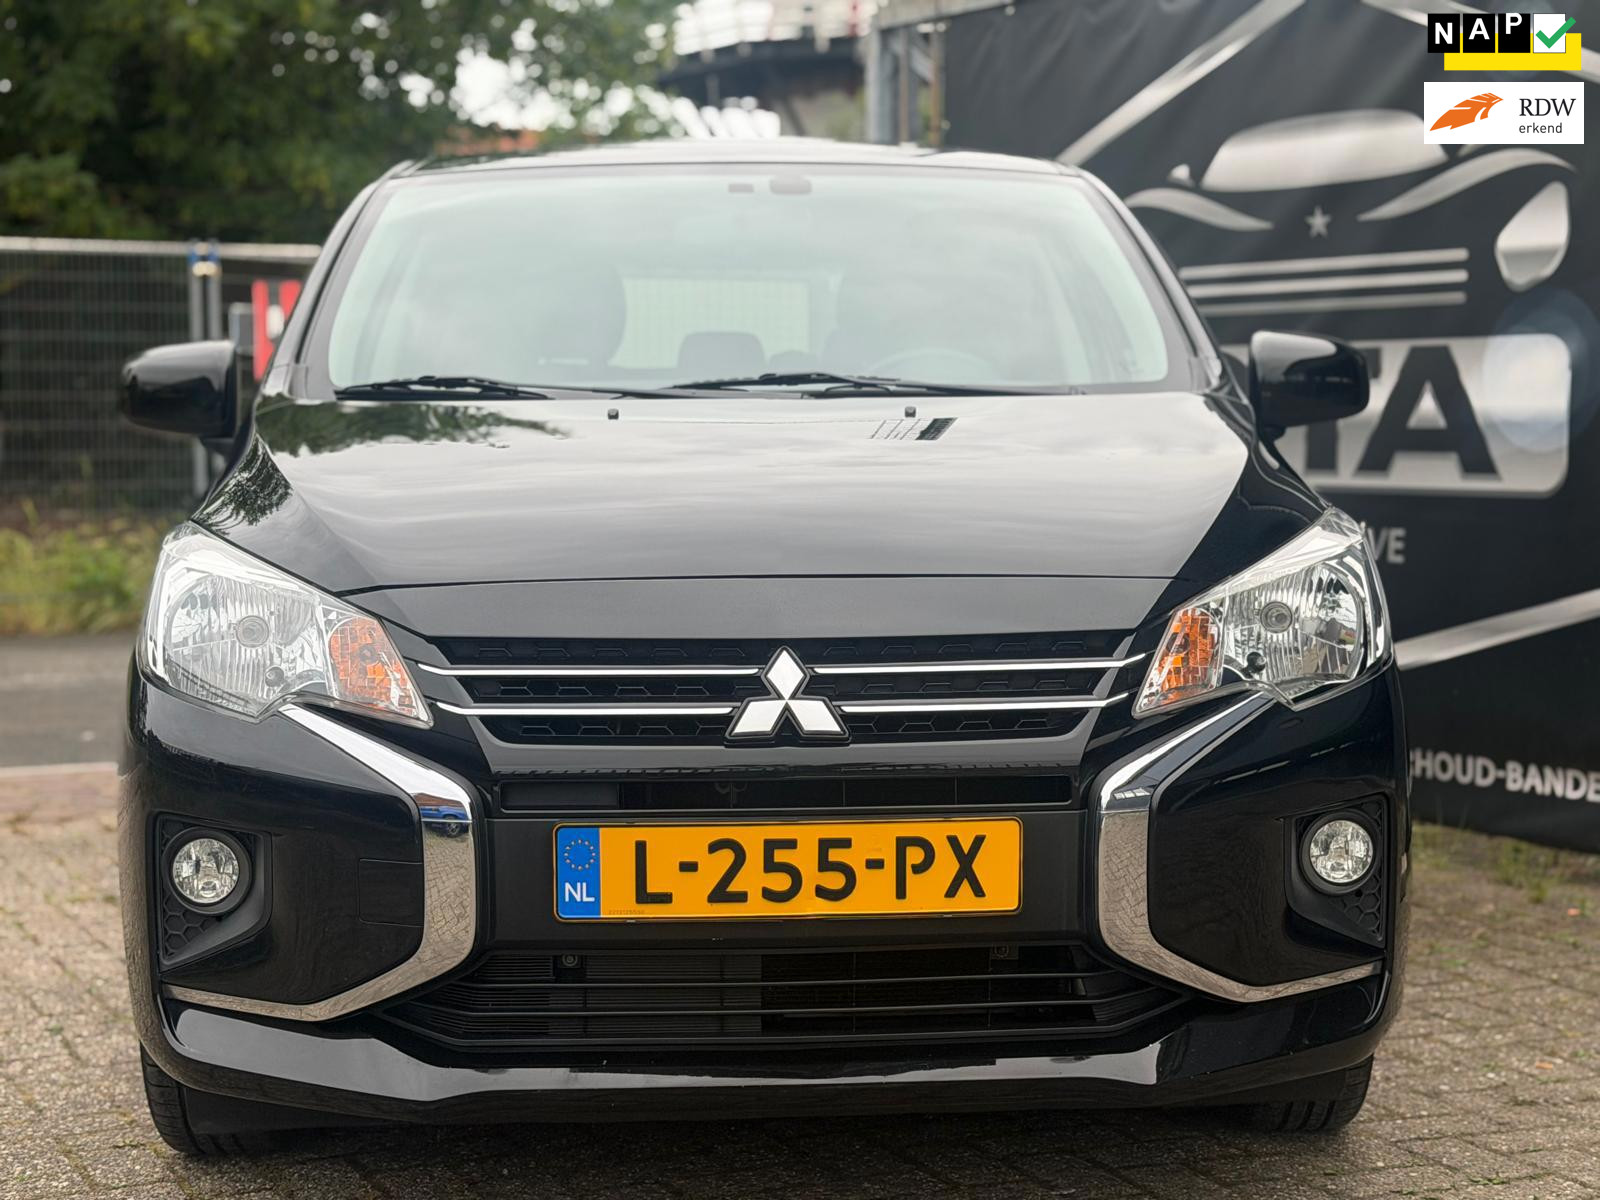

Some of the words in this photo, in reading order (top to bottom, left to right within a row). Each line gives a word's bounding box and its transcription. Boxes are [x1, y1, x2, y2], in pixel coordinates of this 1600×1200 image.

[1410, 747, 1600, 803] HOUD-BANDE
[564, 882, 596, 903] NL
[634, 834, 987, 905] L-255-PX
